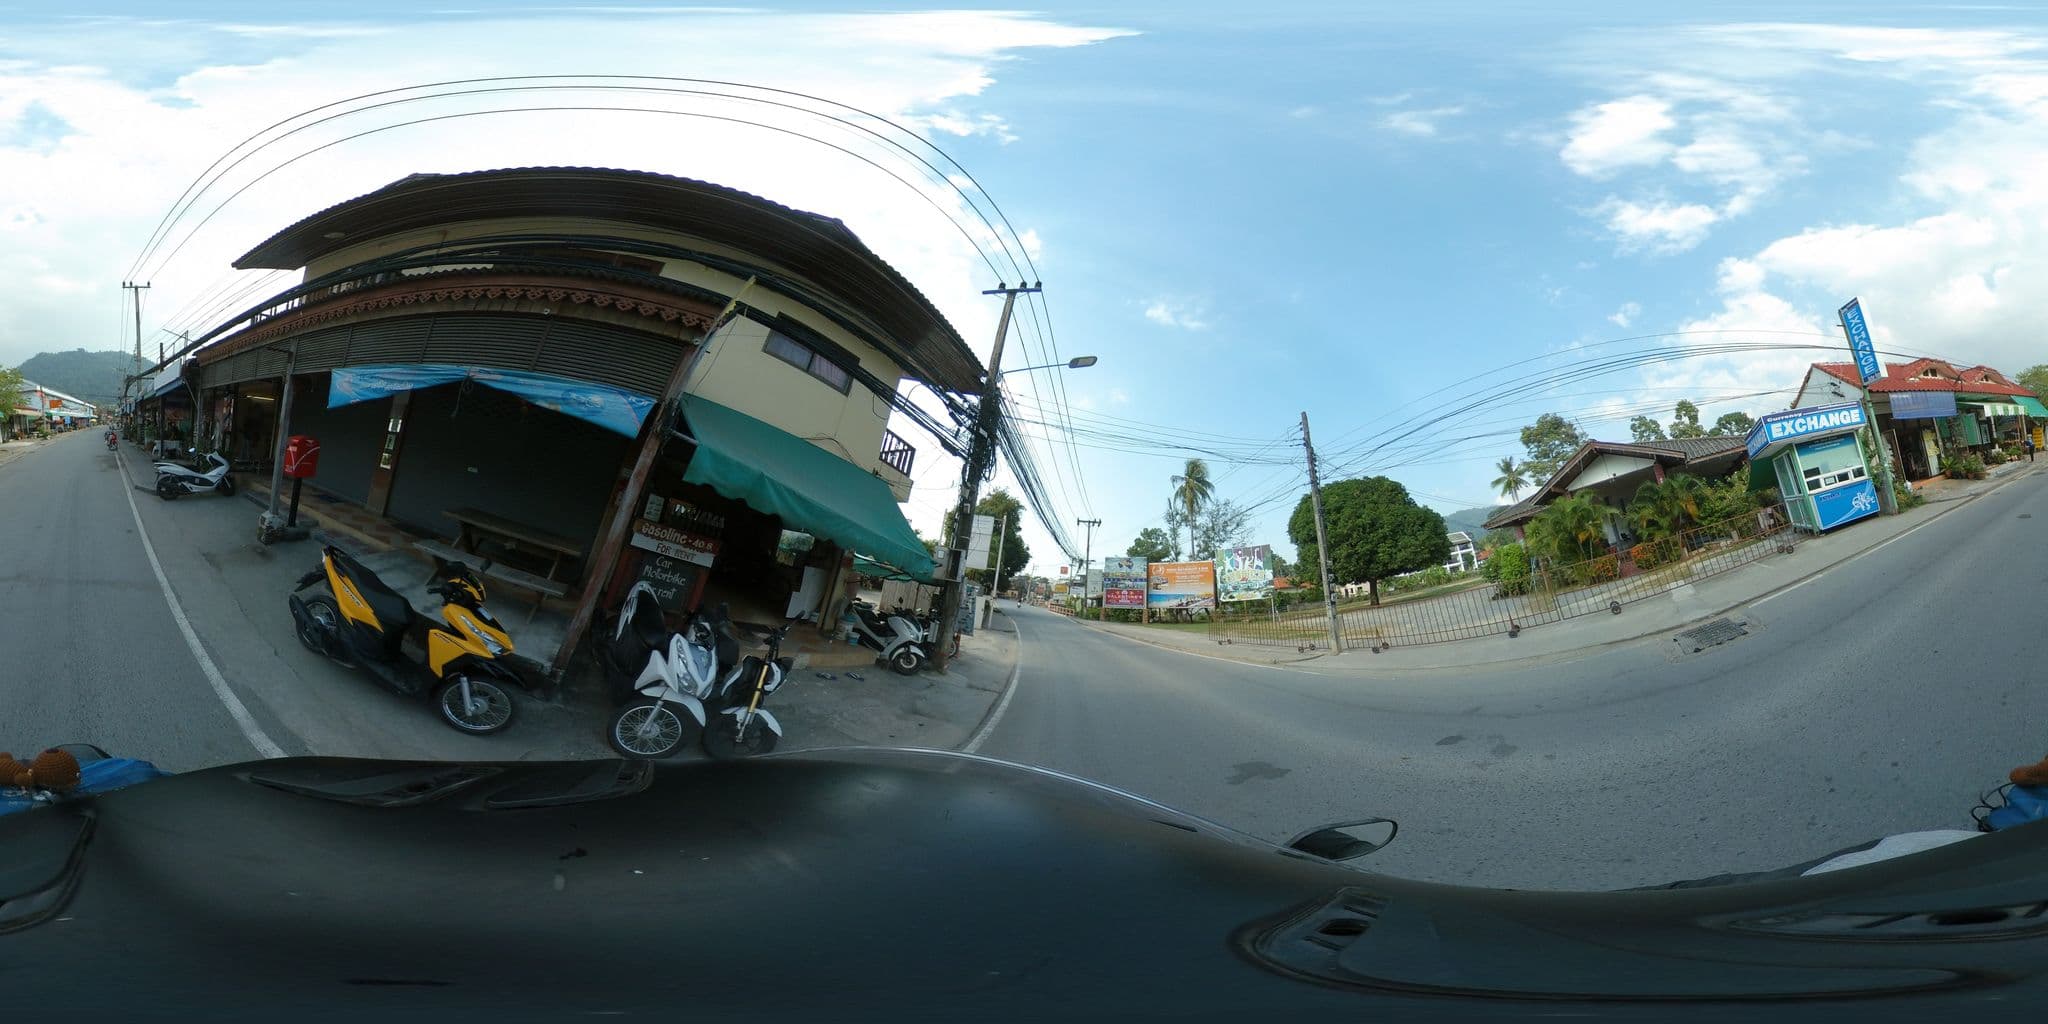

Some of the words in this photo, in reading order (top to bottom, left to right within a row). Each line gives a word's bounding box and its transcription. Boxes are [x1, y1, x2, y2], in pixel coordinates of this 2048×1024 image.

[1847, 309, 1875, 373] EXCHANGE
[1767, 412, 1802, 422] Currency
[1771, 410, 1861, 437] EXCHANGE
[642, 523, 687, 544] Gasoline
[656, 543, 672, 556] FOR
[674, 549, 697, 562] RENT
[656, 556, 673, 569] Car
[643, 565, 686, 585] Motorbike
[658, 587, 676, 600] rent
